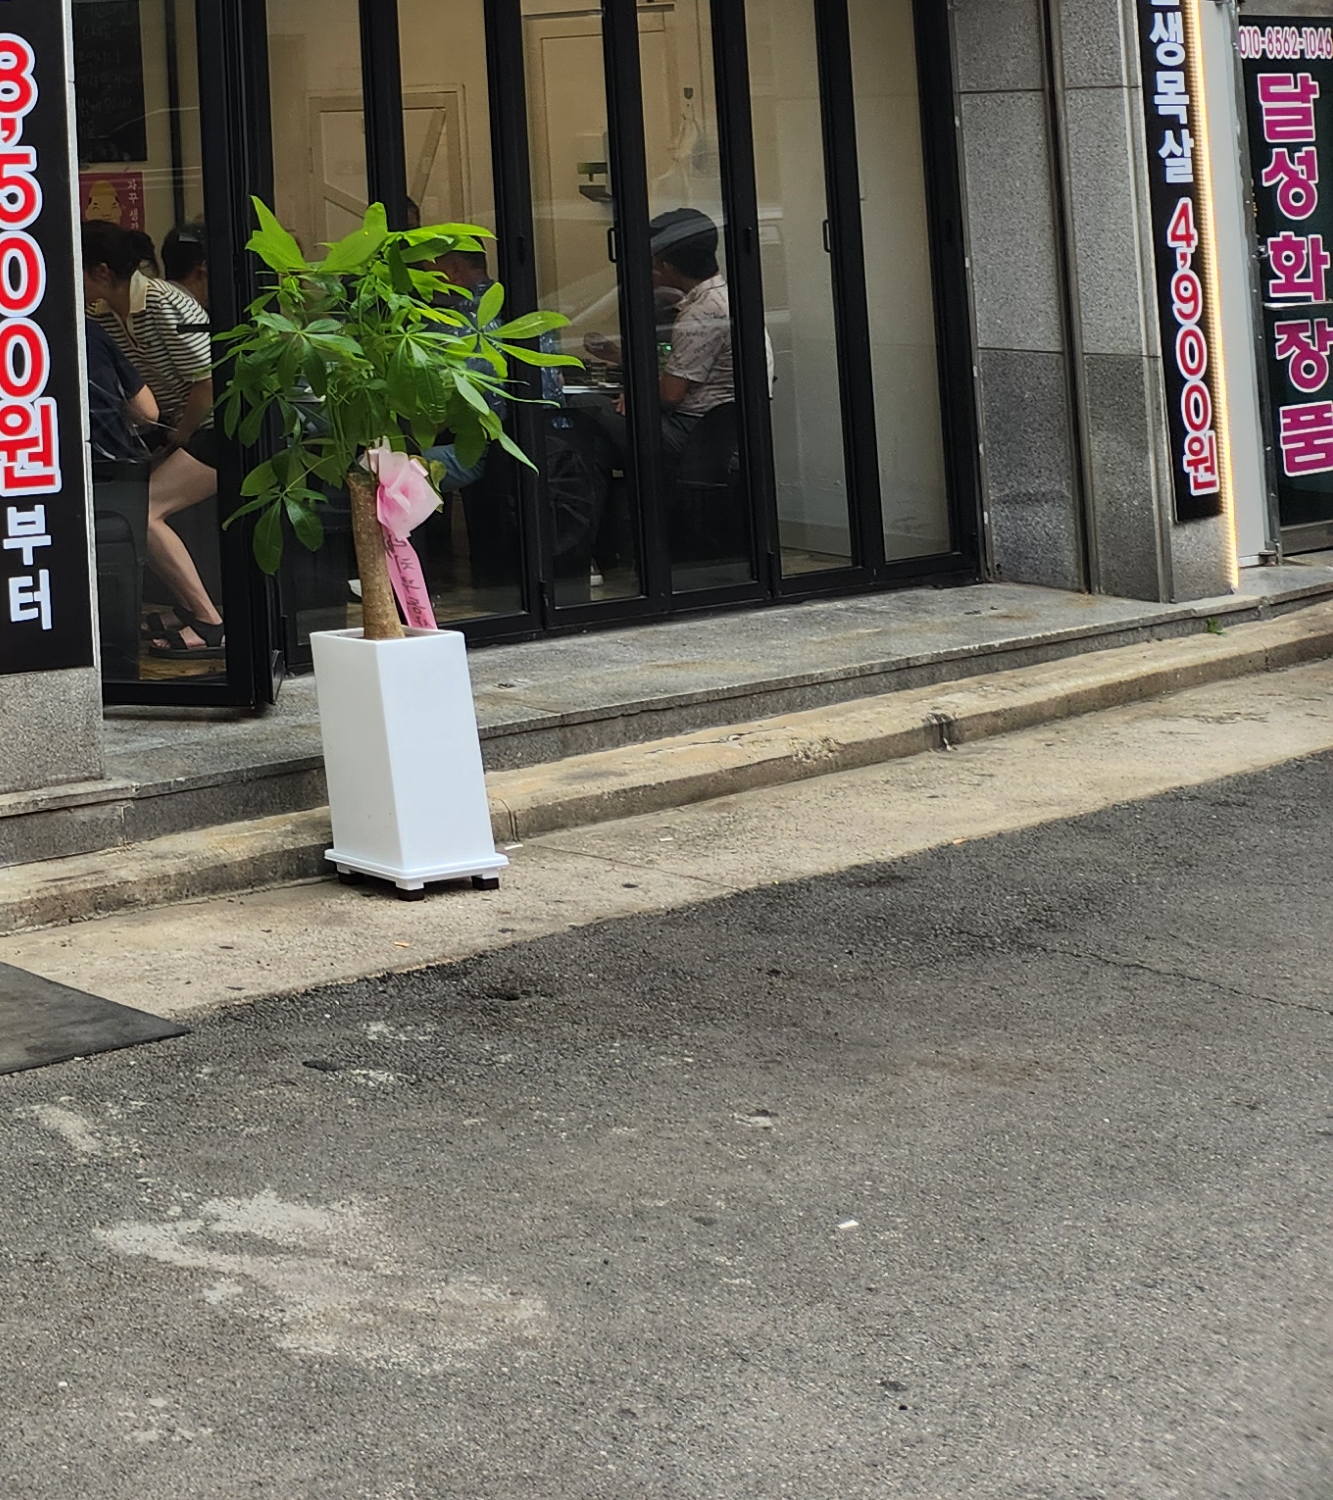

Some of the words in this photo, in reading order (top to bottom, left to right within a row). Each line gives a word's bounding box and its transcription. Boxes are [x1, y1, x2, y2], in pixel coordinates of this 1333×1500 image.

[1238, 25, 1333, 60] 010-8562-1046
[1167, 197, 1220, 497] 4,900원
[1256, 71, 1333, 477] 달성화장품
[2, 504, 53, 631] 부터
